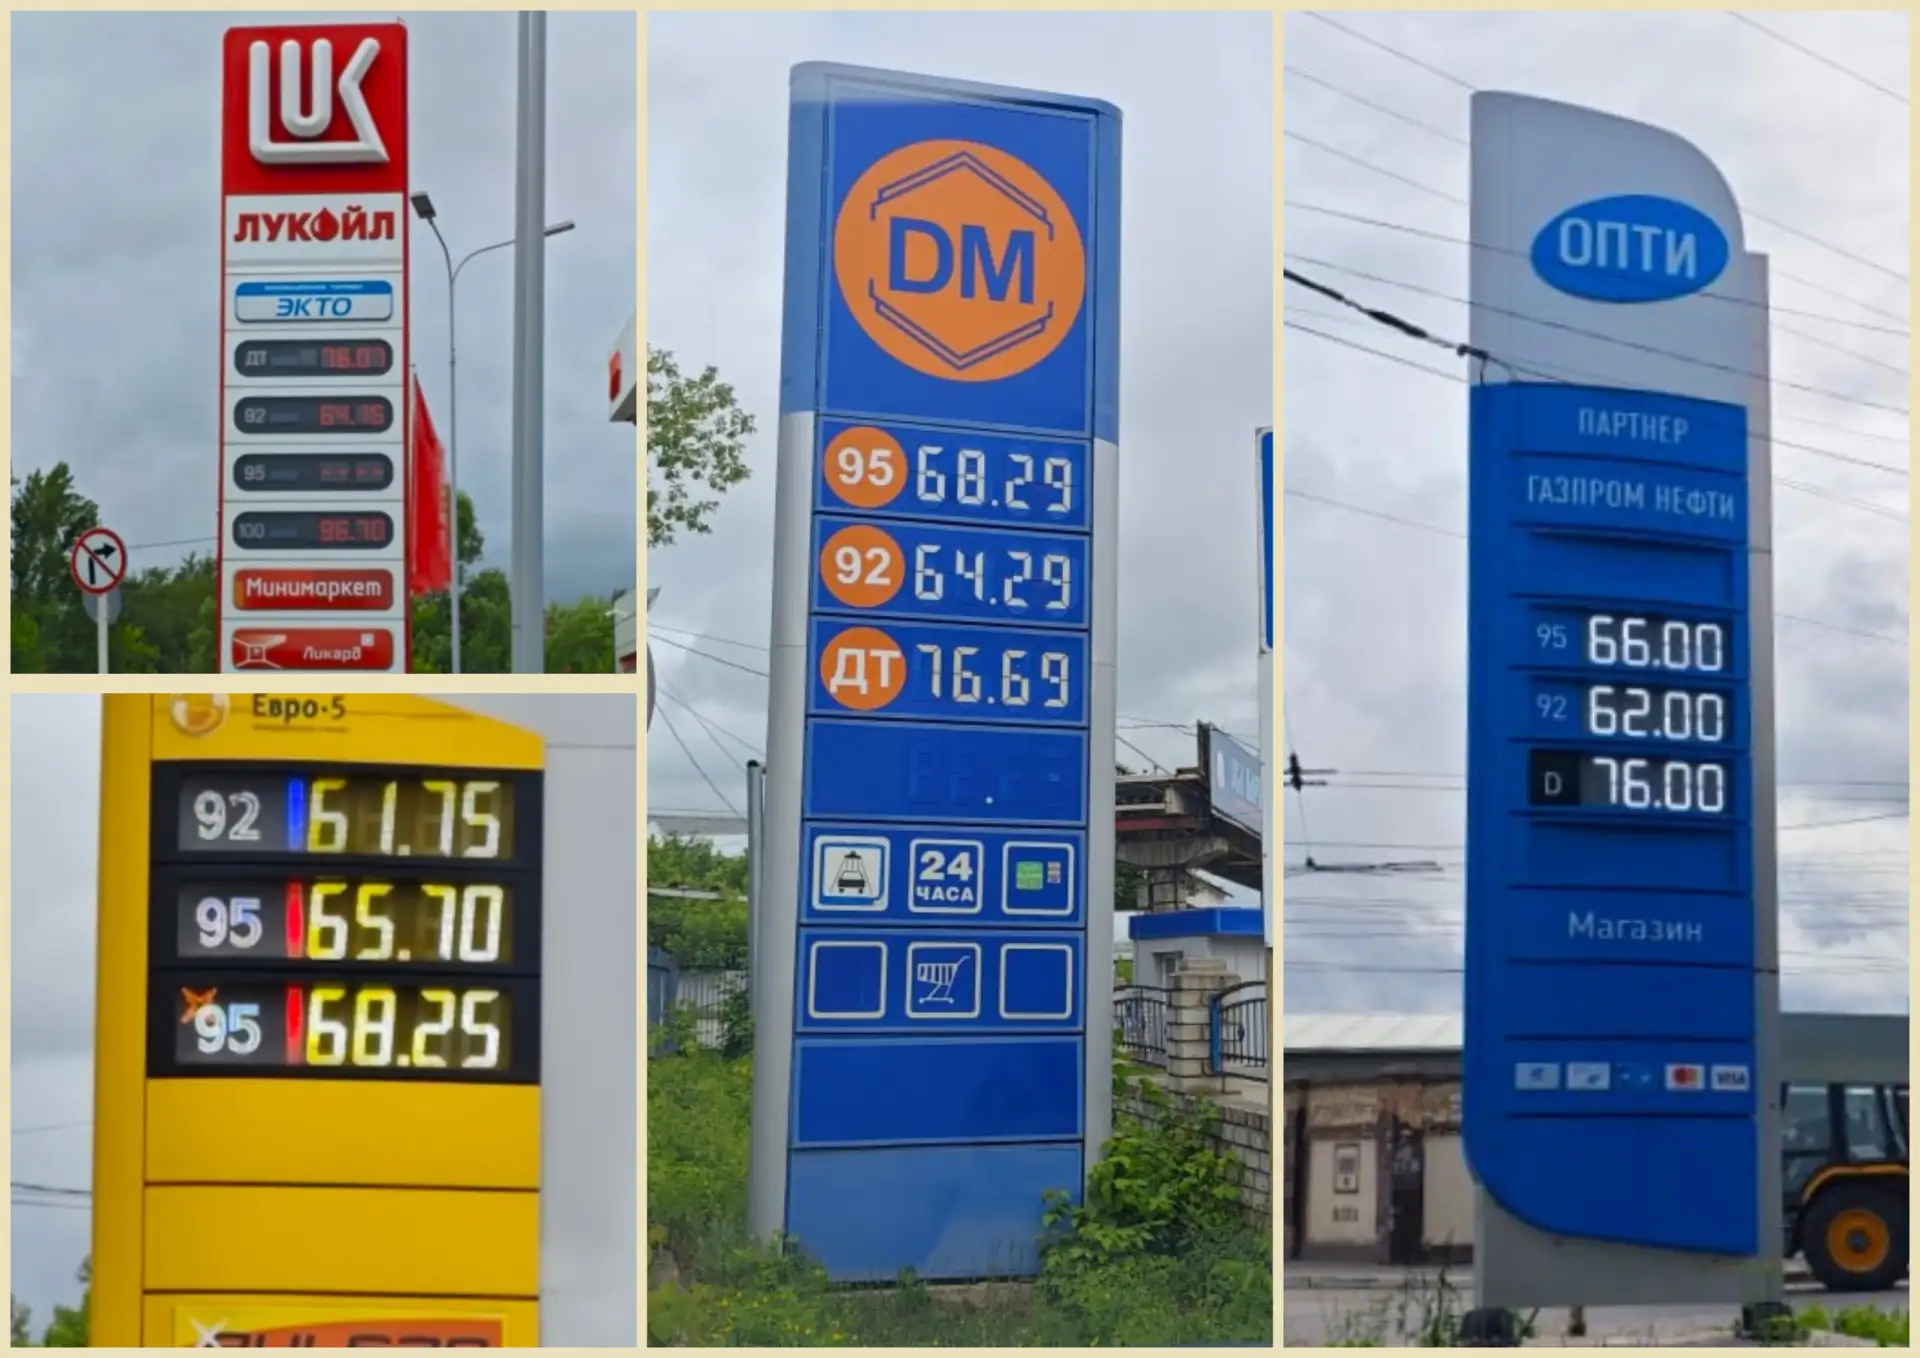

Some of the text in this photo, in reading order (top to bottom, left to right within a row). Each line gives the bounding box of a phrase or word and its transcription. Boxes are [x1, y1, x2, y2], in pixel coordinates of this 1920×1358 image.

[234, 205, 395, 242] ЛУКОЙЛ
[889, 216, 1035, 305] DM
[1558, 217, 1697, 280] ОПТИ
[276, 297, 352, 317] ЭКТО
[245, 350, 267, 366] ДТ
[244, 407, 266, 424] 92
[1578, 408, 1689, 444] ПАРТНЕР
[244, 464, 266, 481] 95
[837, 446, 1072, 513] 95 68.29
[1528, 475, 1735, 522] ГАЗПРОМ НЕФТИ
[239, 523, 265, 539] 100
[246, 577, 381, 602] Минимаркет
[835, 545, 1070, 610] 92 64.29
[303, 646, 362, 662] Ликард
[1536, 615, 1723, 671] 95 66.00
[829, 644, 1069, 707] ДТ 76.69
[1536, 686, 1724, 742] 92 62.00
[1544, 757, 1724, 812] D 76.00
[194, 779, 500, 858] 92 61.75
[919, 851, 973, 881] 24
[915, 886, 974, 902] ЧАСА
[196, 883, 504, 962] 95 65.70
[1568, 912, 1703, 942] Магазин
[195, 988, 500, 1068] 95 68.25
